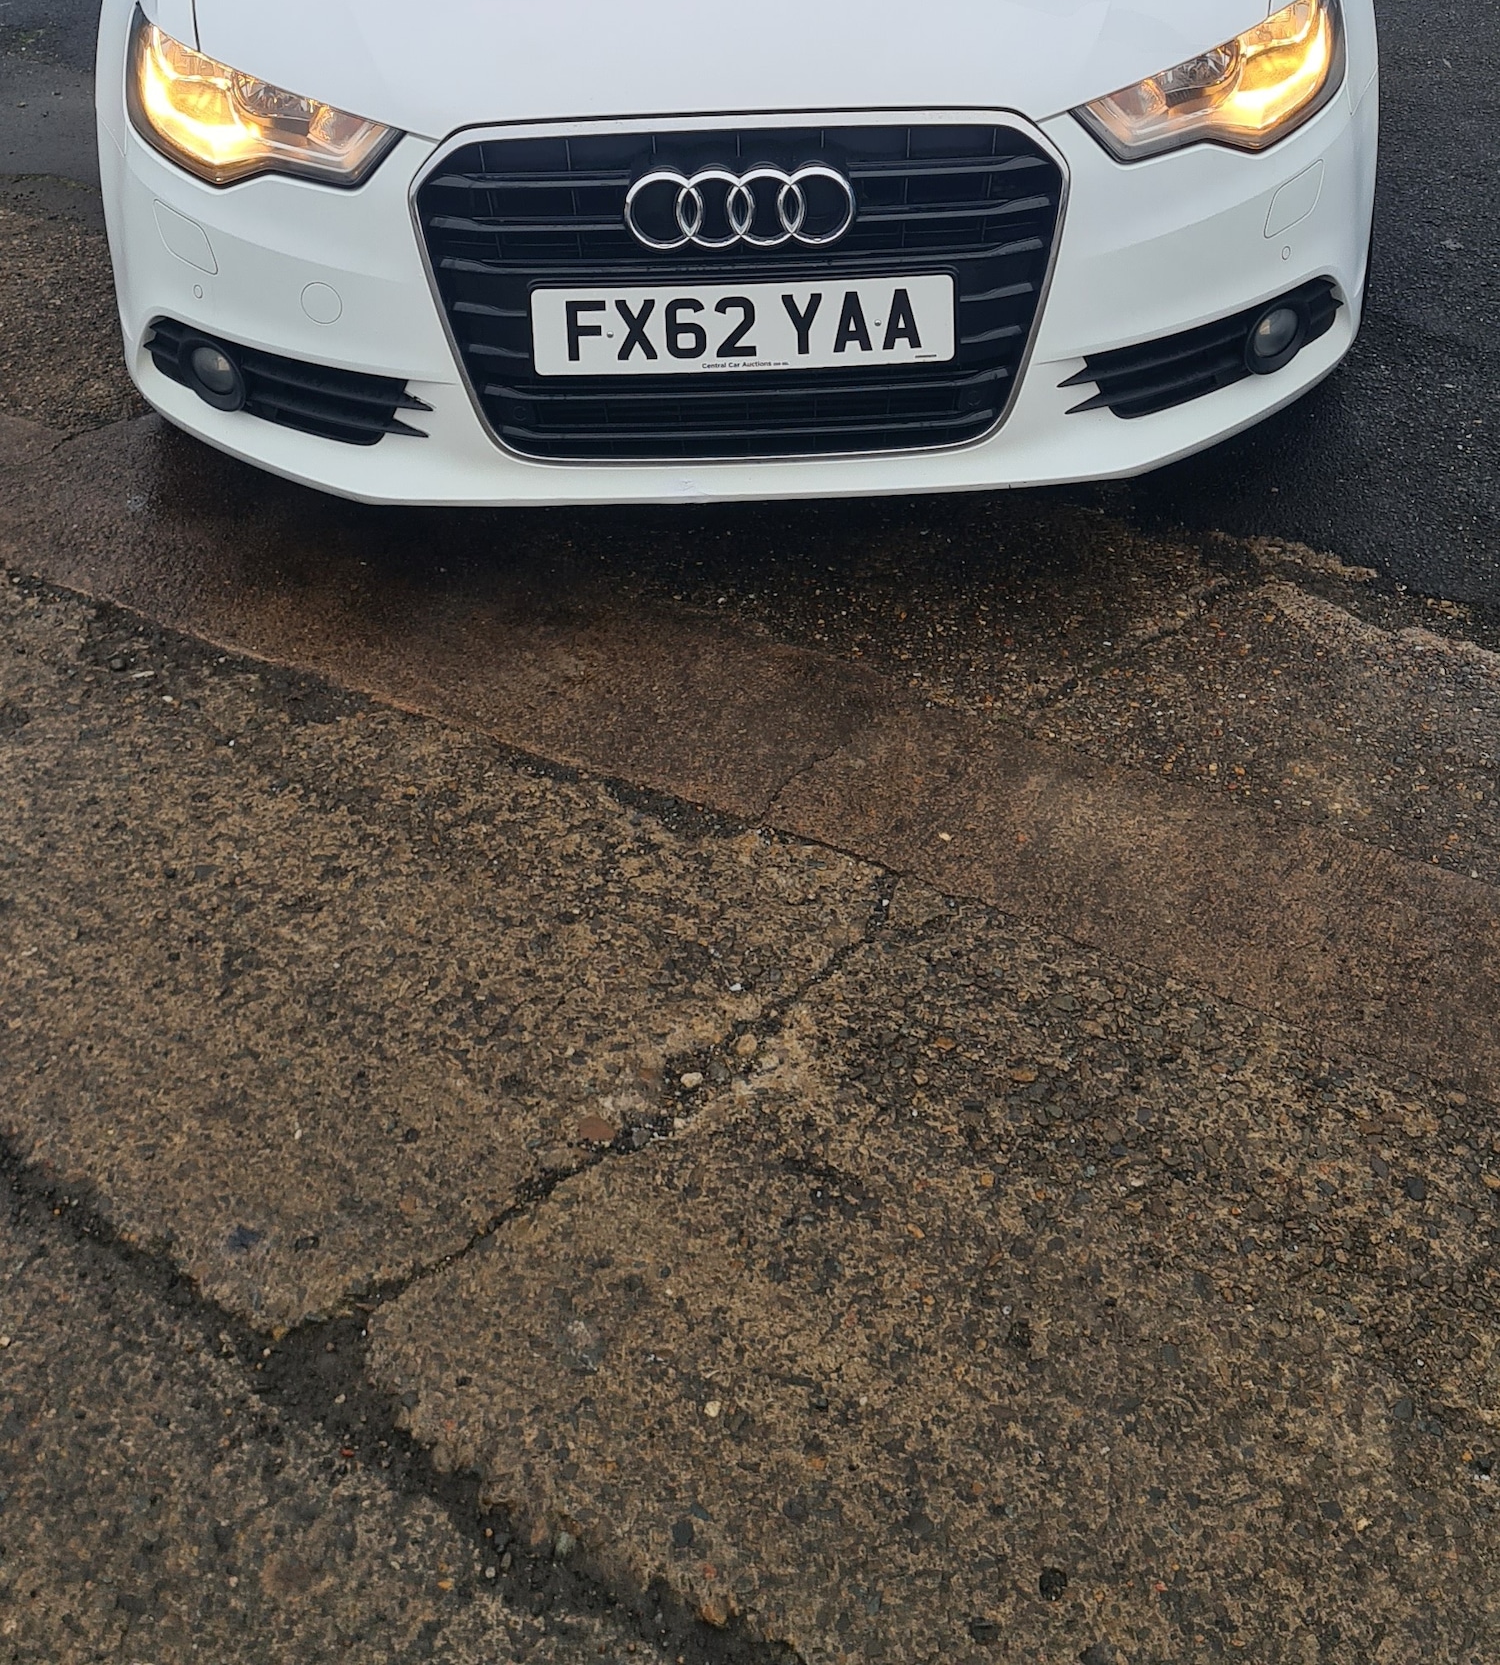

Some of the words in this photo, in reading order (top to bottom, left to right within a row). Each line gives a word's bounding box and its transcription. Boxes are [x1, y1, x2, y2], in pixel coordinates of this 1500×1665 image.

[565, 296, 757, 362] FX62
[781, 288, 922, 355] YAA
[702, 362, 727, 370] Central
[741, 360, 772, 368] Auctions
